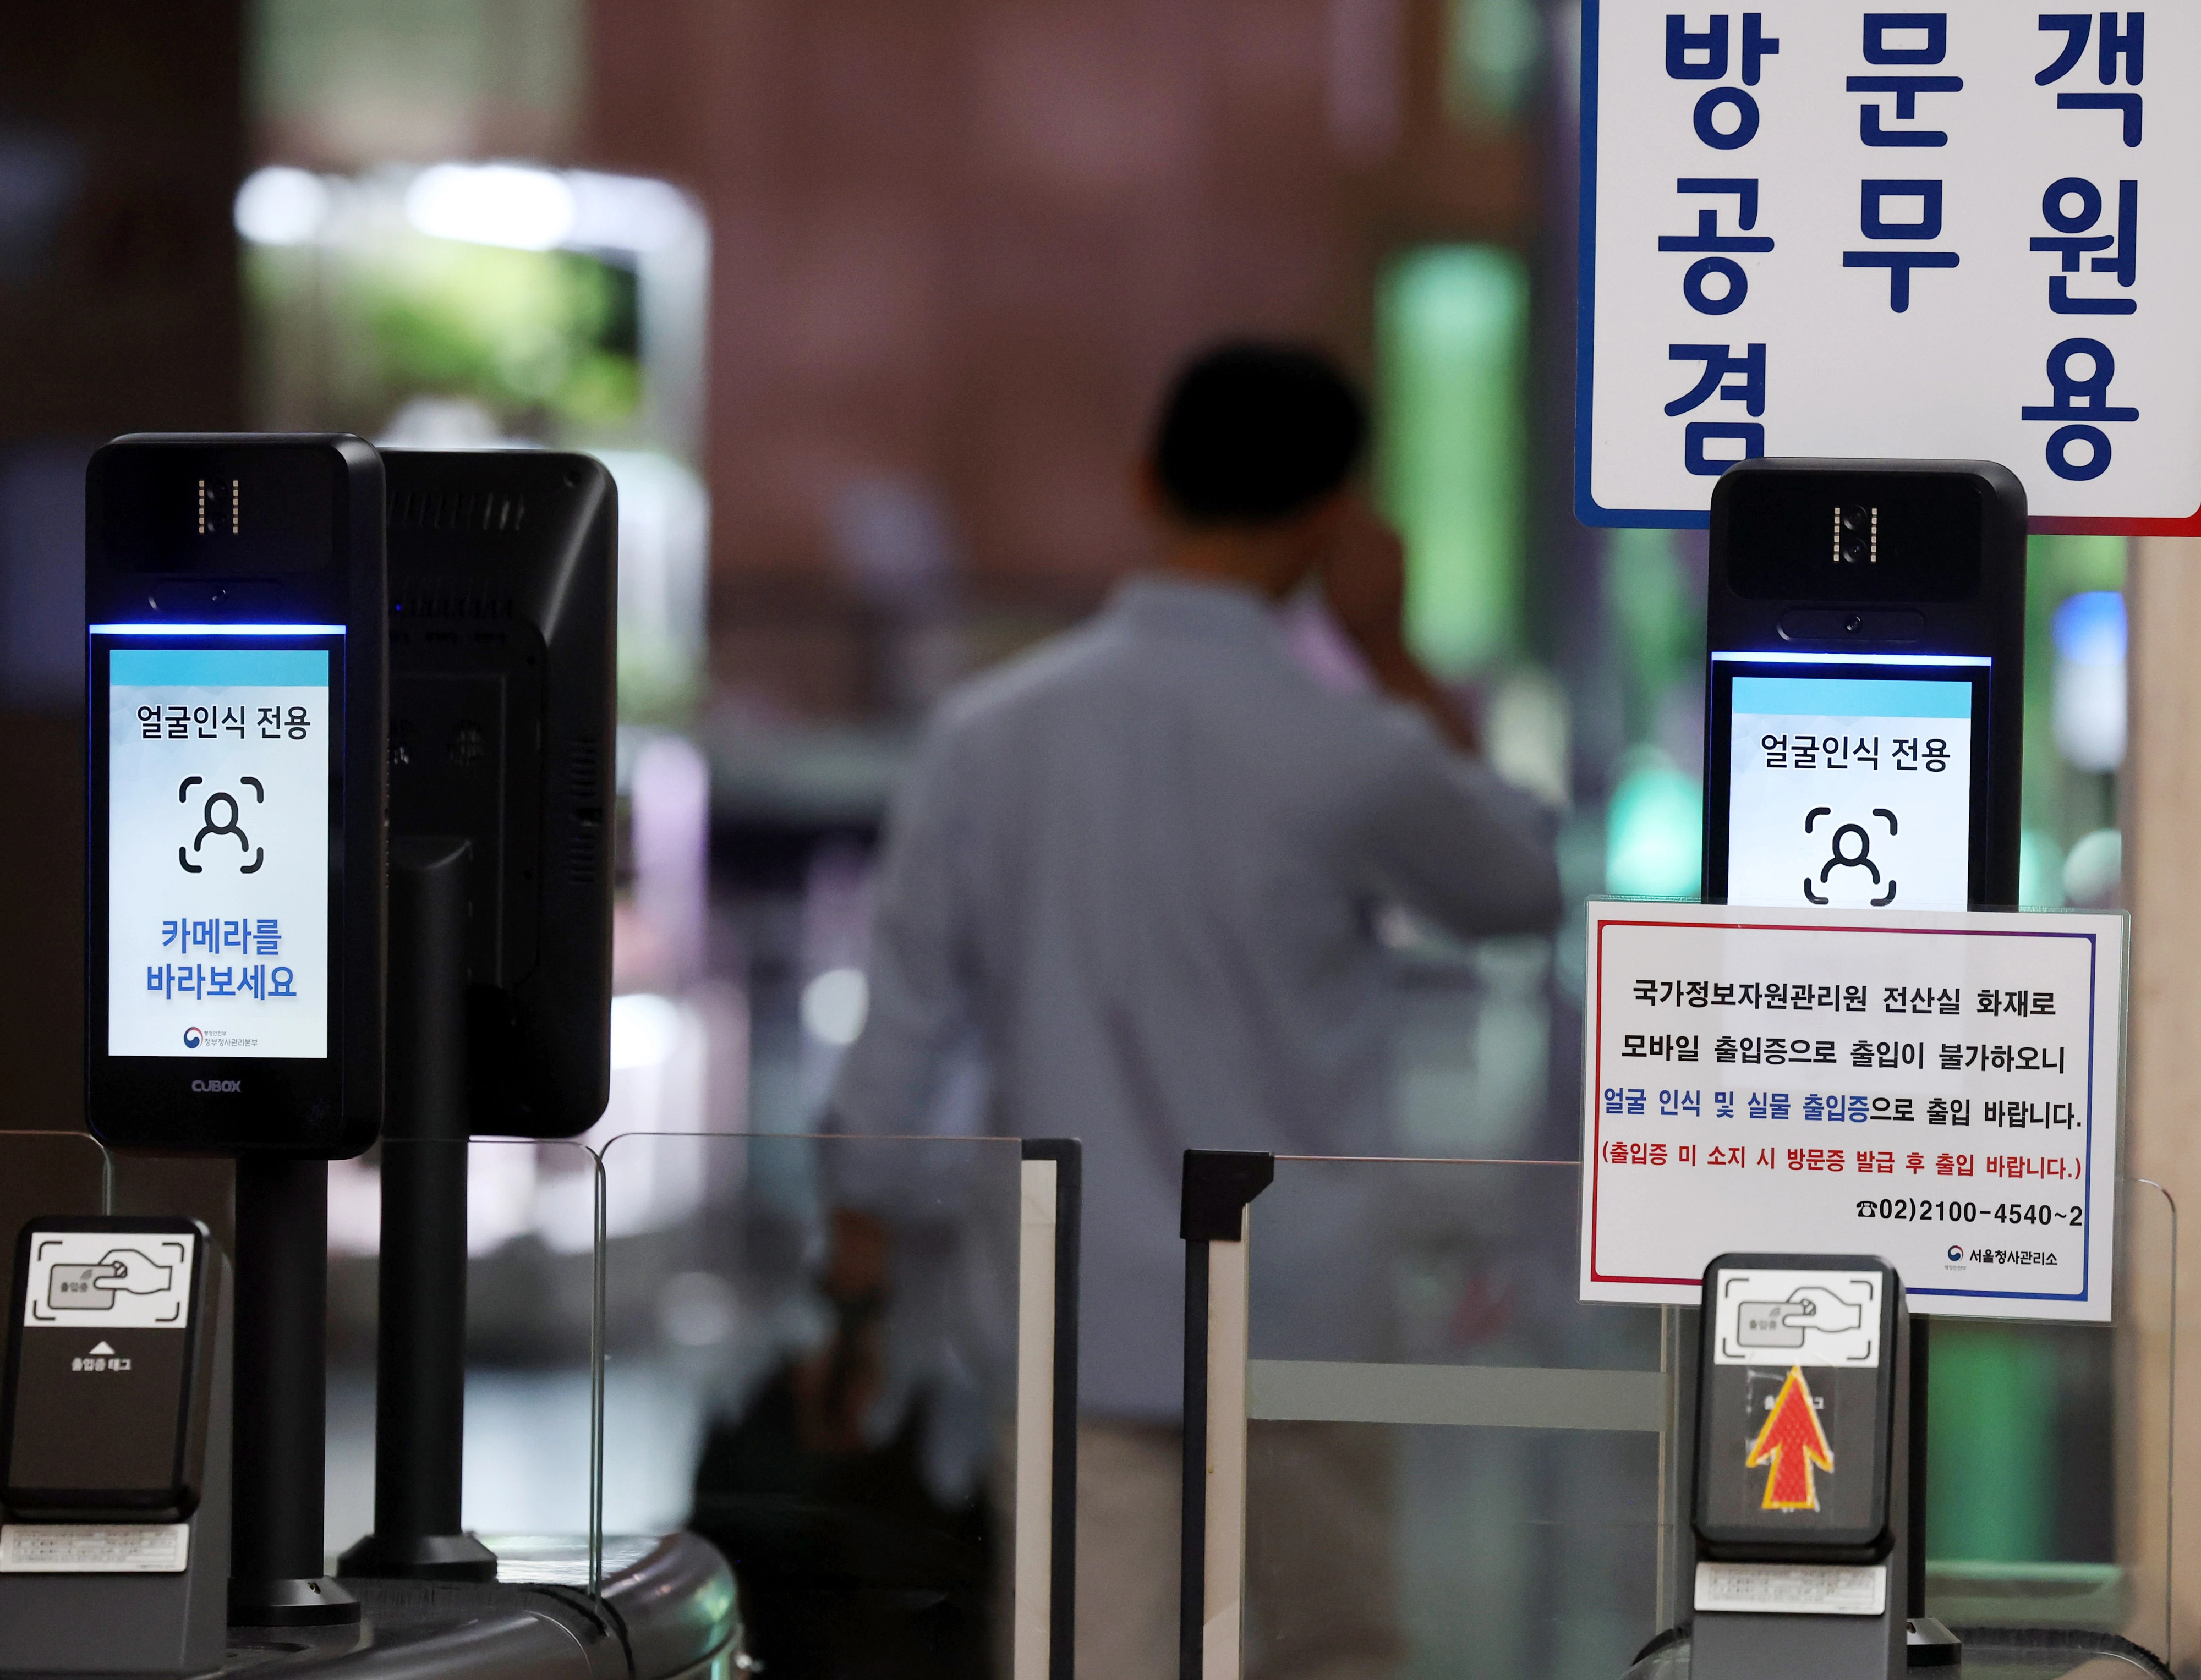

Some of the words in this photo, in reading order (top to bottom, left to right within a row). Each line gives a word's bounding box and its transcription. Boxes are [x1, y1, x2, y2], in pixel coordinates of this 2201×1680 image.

[138, 705, 245, 739] 얼굴인식
[257, 706, 311, 740] 전용
[1761, 734, 1879, 770] 얼굴인식
[1892, 738, 1951, 772] 전용
[162, 918, 282, 956] 카메라를
[147, 963, 297, 1001] 바라보세요
[1633, 979, 1866, 1012] 국가정보자원관리원
[1883, 986, 1960, 1015] 전산실
[1976, 989, 2056, 1018] 화재로
[204, 1039, 258, 1047] 정부청사관리본부
[1622, 1034, 1699, 1062] 모바일
[1714, 1036, 1837, 1065] 출입증으로
[1850, 1040, 1924, 1069] 출입이
[1939, 1044, 2065, 1074] 불가하오니
[191, 1080, 242, 1092] CUBOX
[1604, 1088, 1646, 1115] 얼굴
[1659, 1089, 1700, 1117] 인식
[1715, 1091, 1734, 1118] 및
[1748, 1092, 1791, 1119] 실물
[1803, 1094, 1914, 1123] 출입증으로
[1926, 1097, 1970, 1126] 출입
[1984, 1100, 2081, 1130] 바랍니다.
[1602, 1141, 1668, 1166] (출입증
[1679, 1144, 1696, 1167] 미
[1707, 1146, 1745, 1168] 소지
[1756, 1147, 1775, 1170] 시
[1787, 1148, 1846, 1172] 방문증
[1857, 1150, 1895, 1174] 발급
[1906, 1152, 1925, 1174] 후
[1935, 1153, 1974, 1177] 출입
[1986, 1155, 2081, 1180] 바랍니다.)
[1969, 1249, 2057, 1266] 서울청사관리소
